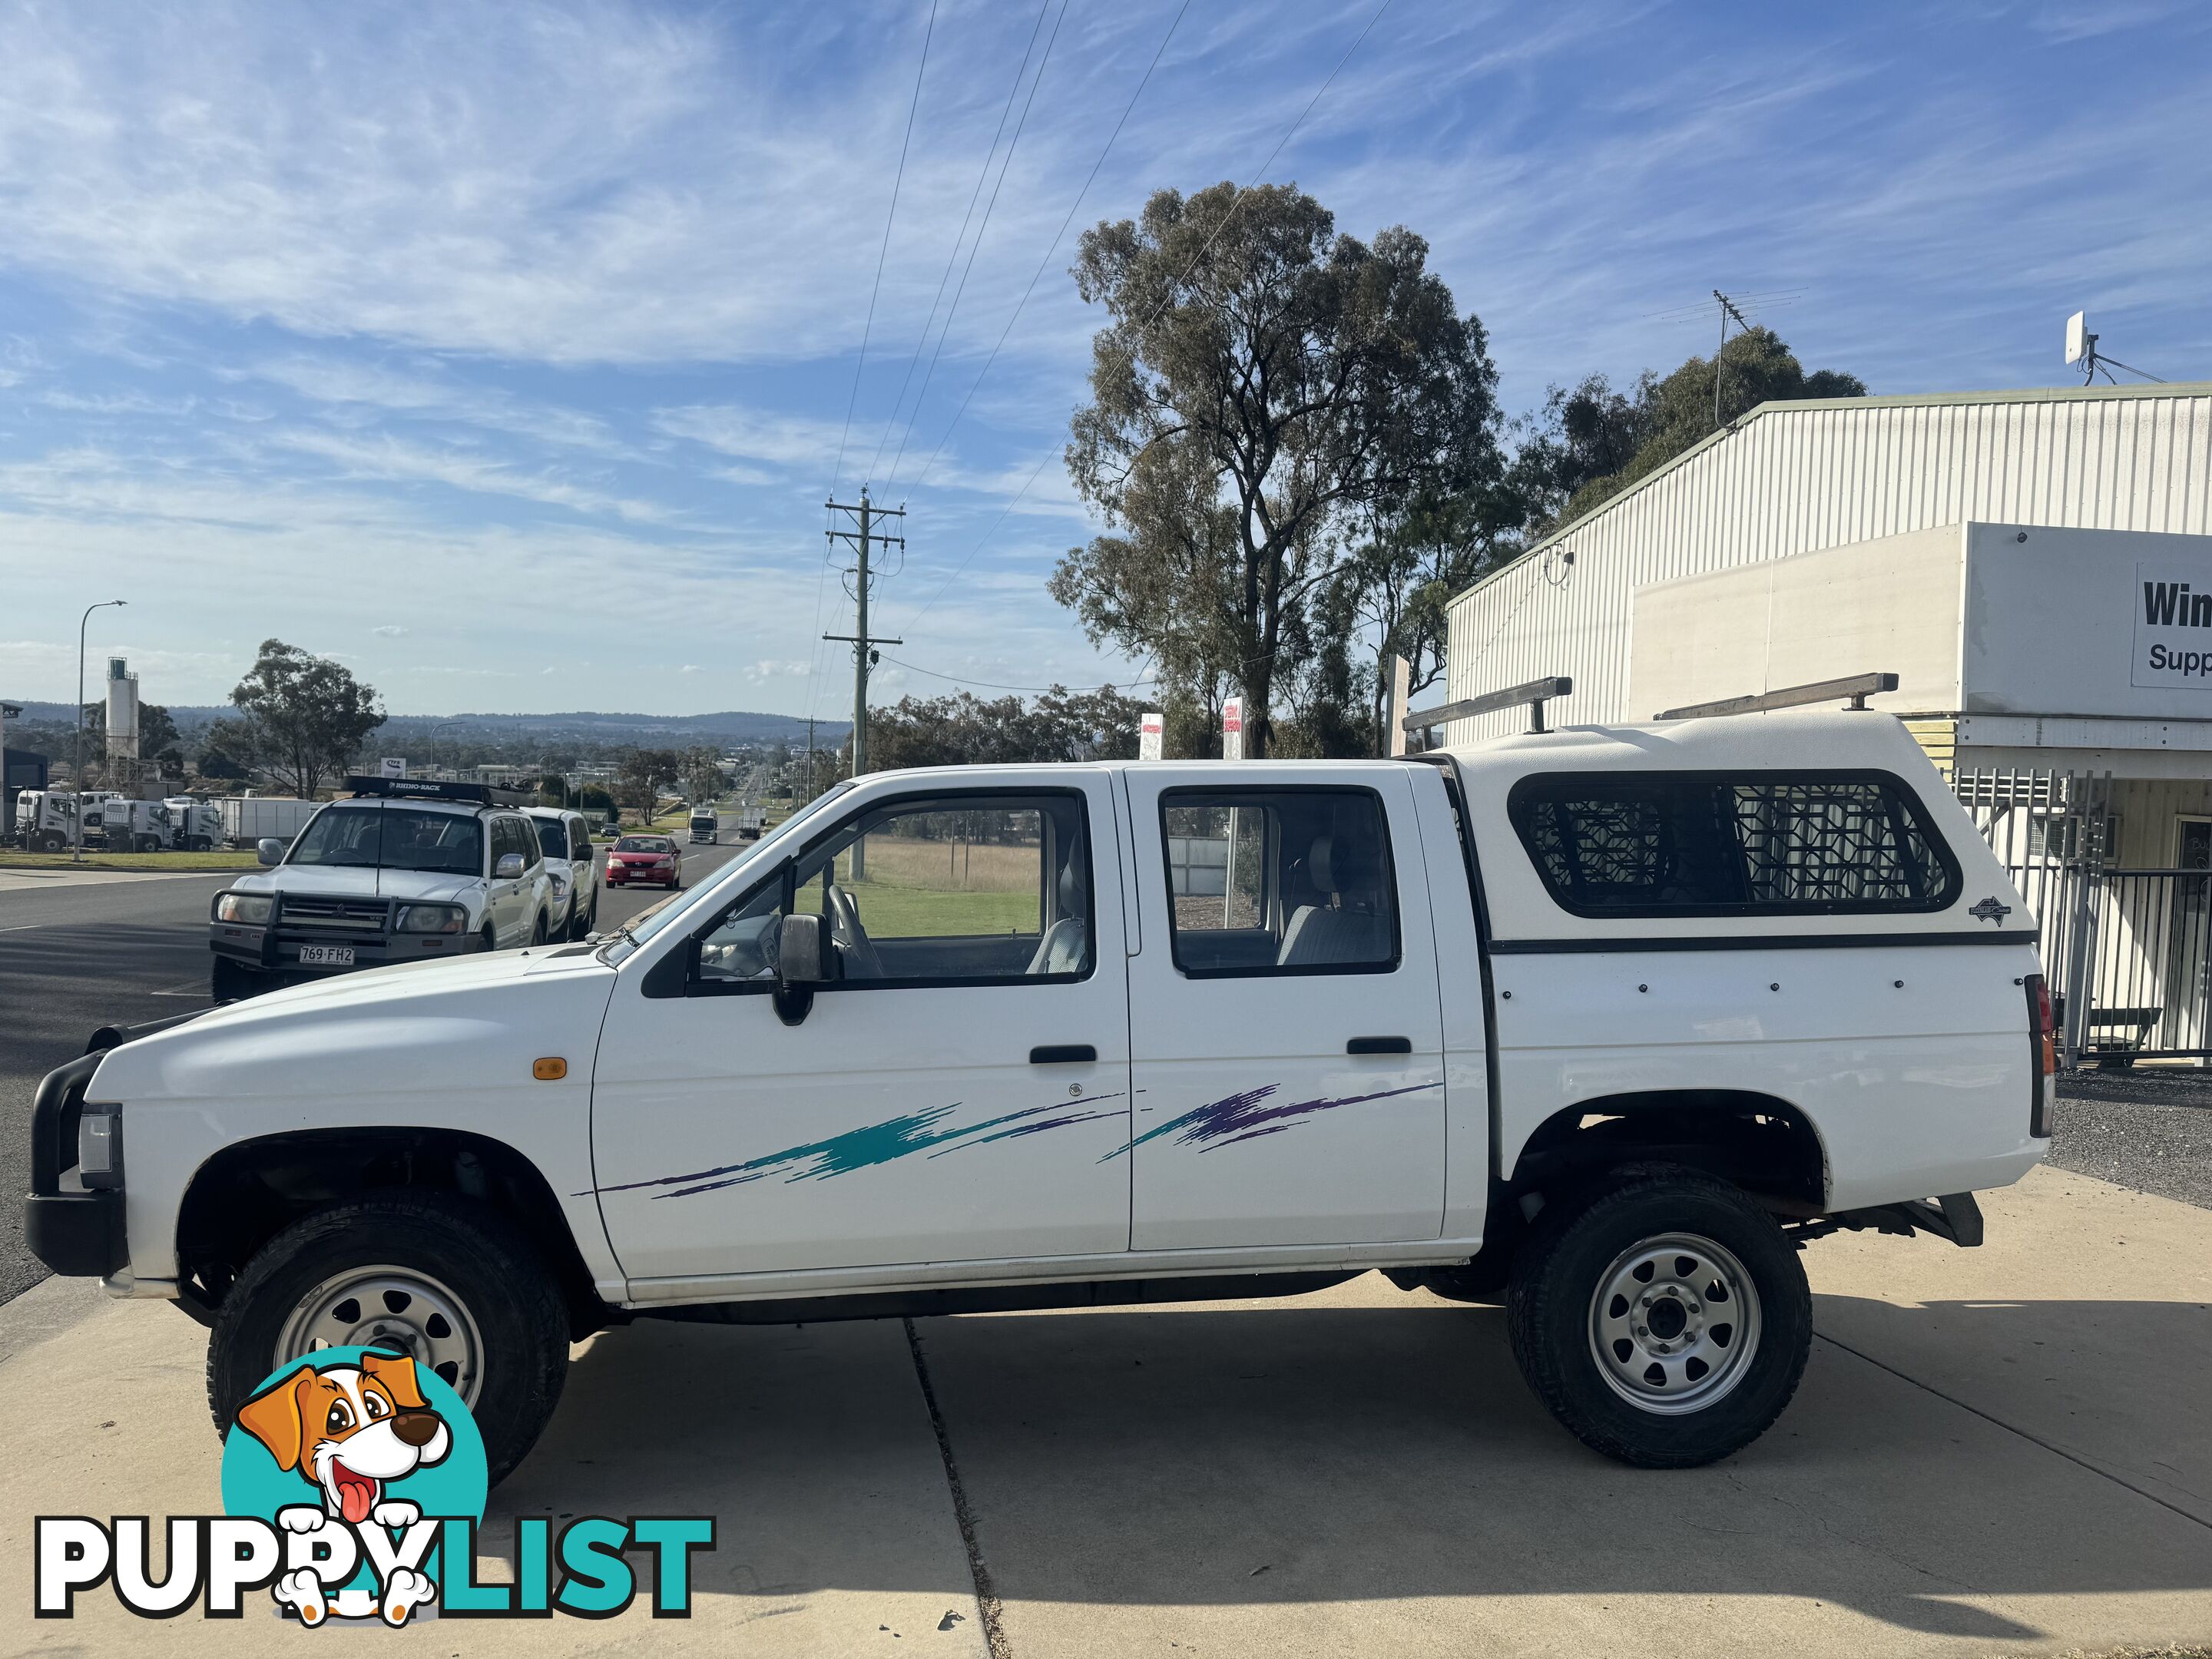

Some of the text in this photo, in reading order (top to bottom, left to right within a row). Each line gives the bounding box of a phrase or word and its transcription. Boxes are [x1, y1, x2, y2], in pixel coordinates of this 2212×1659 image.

[2144, 581, 2212, 628] Win
[2149, 644, 2212, 677] Supp
[396, 783, 441, 791] RHINO-RACK
